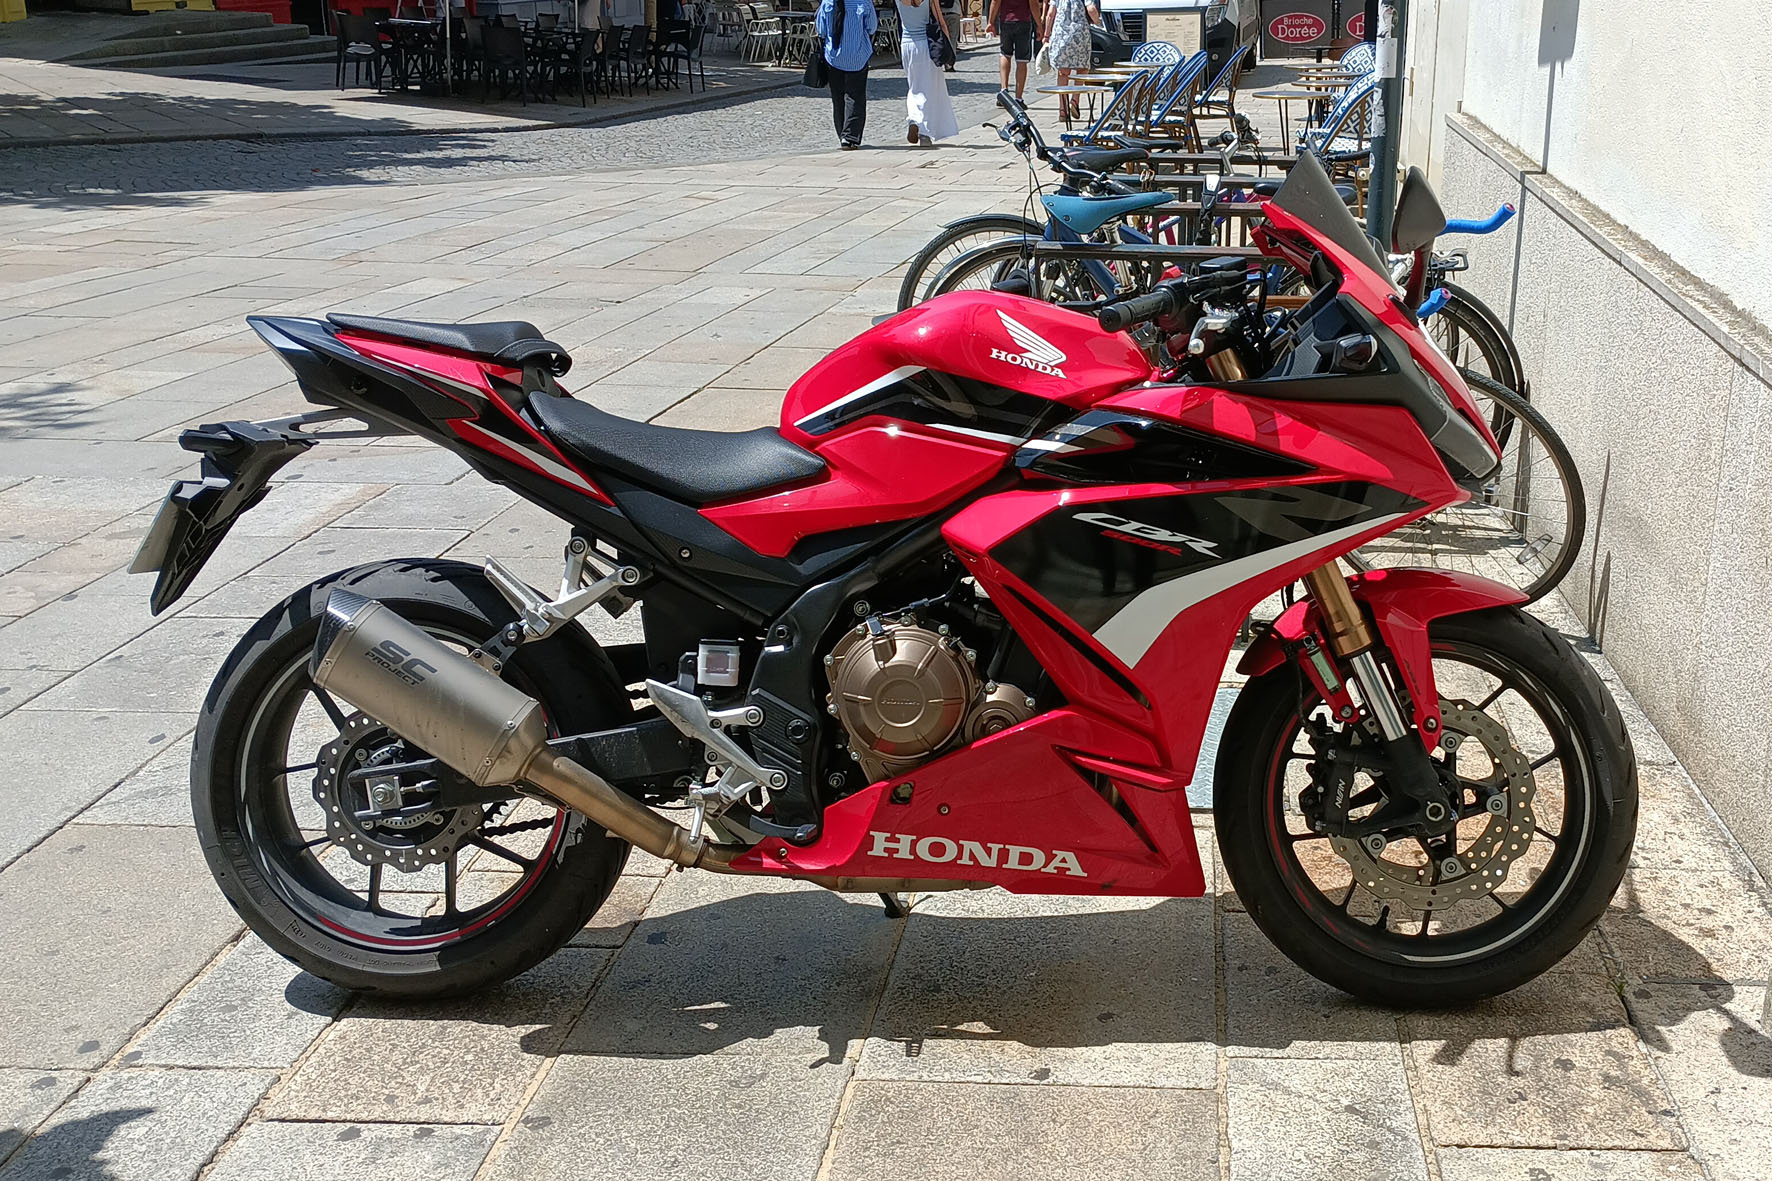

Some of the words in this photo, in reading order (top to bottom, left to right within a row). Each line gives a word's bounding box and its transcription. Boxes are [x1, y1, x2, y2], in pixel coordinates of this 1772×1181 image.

[1277, 25, 1318, 38] Dorée
[1283, 17, 1314, 26] Brioche
[990, 347, 1068, 379] HONDA
[1072, 512, 1223, 559] CBR
[364, 650, 420, 687] PROJECT
[371, 639, 438, 682] SC
[867, 830, 1088, 877] HONDA
